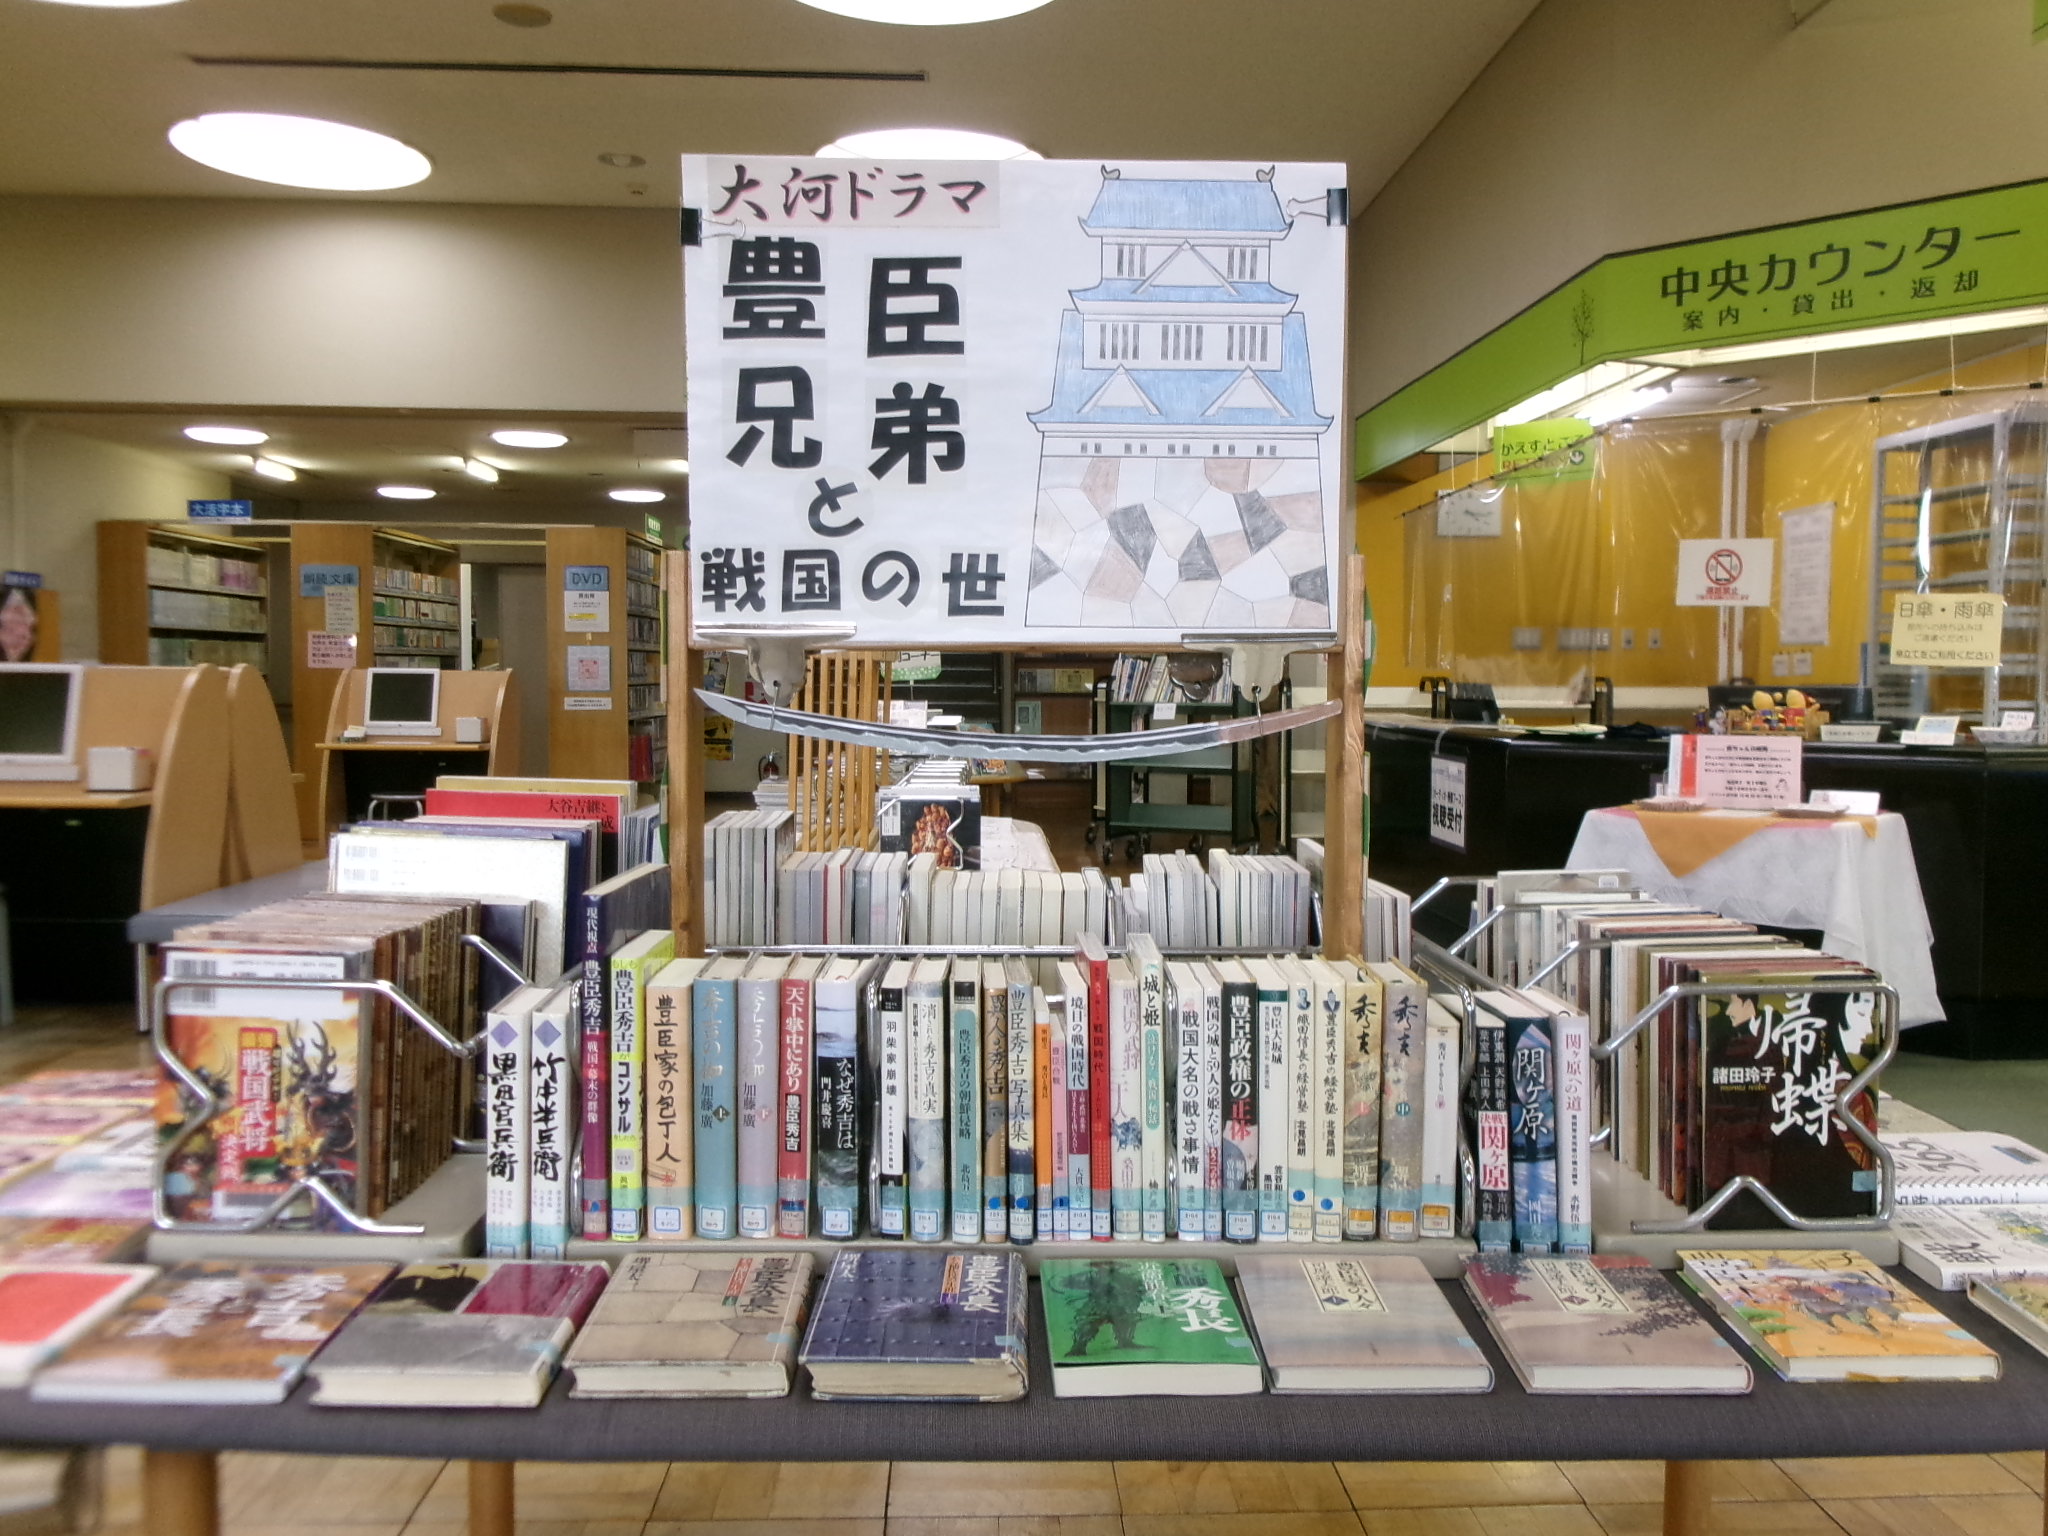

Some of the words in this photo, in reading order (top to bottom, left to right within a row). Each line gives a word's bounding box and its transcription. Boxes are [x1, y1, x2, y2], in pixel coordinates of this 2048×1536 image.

[712, 165, 986, 222] 大河ドラマ
[722, 236, 965, 358] 豊臣
[1661, 226, 2021, 307] 中央カウンター
[726, 365, 966, 484] 兄弟
[192, 502, 244, 516] 大活字本
[807, 477, 864, 537] と
[572, 573, 602, 585] DVD
[700, 547, 1006, 617] 戦国の世
[1900, 601, 1994, 618] 日傘・雨傘
[584, 960, 602, 1035] 豊臣秀吉
[614, 970, 635, 1053] 豊臣秀吉
[1143, 973, 1160, 1027] 城と姫
[1271, 1006, 1283, 1064] 豊臣大坂城
[786, 986, 804, 1092] 天下掌中にあり
[886, 1021, 897, 1097] 羽柴家崩壊
[1071, 996, 1084, 1087] 境目の戦国時代
[1229, 995, 1252, 1140] 豊臣政権の正体
[1296, 1014, 1310, 1113] 織田信長の経営塾
[1323, 1014, 1338, 1114] 豊臣秀吉の経営塾
[1713, 1066, 1776, 1084] 諸田玲子
[1749, 992, 1851, 1146] 帰蝶
[488, 1052, 519, 1182] 黒田官兵衛
[533, 1052, 566, 1182] 竹中半兵衛
[617, 1062, 632, 1133] コンサル
[654, 994, 681, 1163] 豊臣家の包丁人
[836, 1058, 855, 1149] なぜ秀吉は
[1182, 1010, 1200, 1174] 戦国大名の戦さ事情
[785, 1094, 800, 1151] 豊臣秀吉
[960, 1254, 1004, 1313] 豊臣秀長
[1169, 1287, 1240, 1332] 秀長
